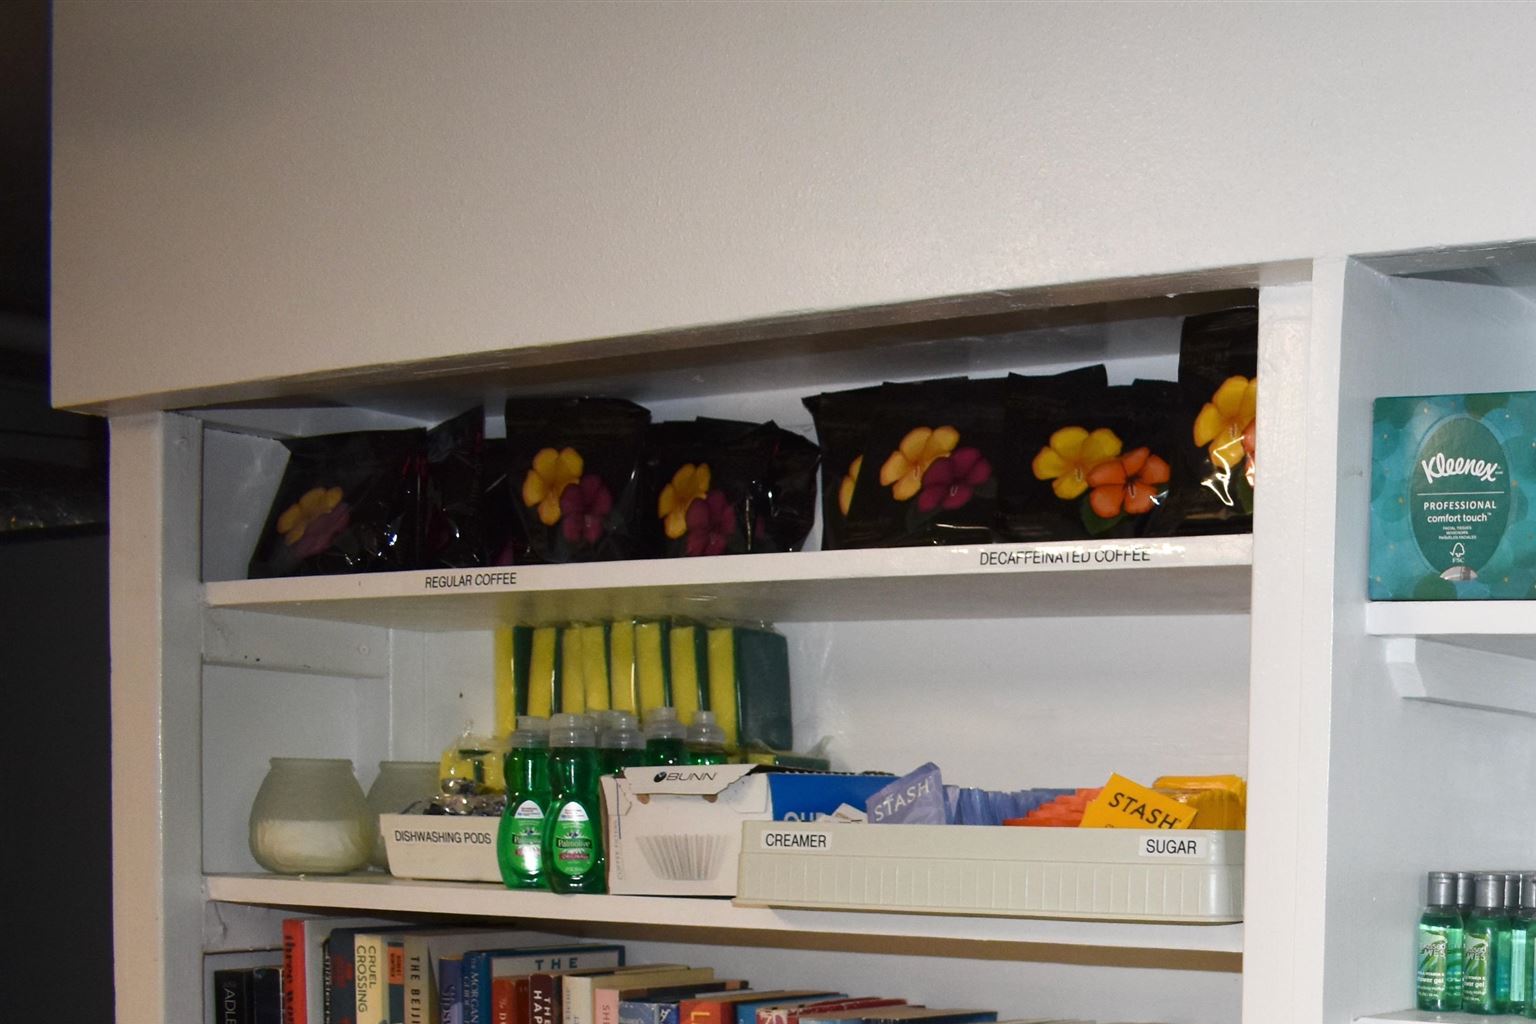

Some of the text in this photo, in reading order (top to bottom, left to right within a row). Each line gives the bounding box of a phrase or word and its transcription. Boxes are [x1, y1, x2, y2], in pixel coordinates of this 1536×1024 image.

[1421, 452, 1498, 484] Kleenex
[1423, 500, 1497, 511] PROFESSIONAL
[980, 549, 1151, 565] DECAFFEINATED COFFEE
[425, 572, 517, 588] REGULAR COFFEE
[666, 772, 717, 782] BUNN
[873, 777, 932, 823] STASH
[1108, 792, 1177, 829] STASH
[395, 831, 491, 844] DISHWASHING PODS
[558, 838, 591, 848] Palmolive
[765, 833, 827, 847] CREAMER
[1146, 839, 1197, 854] SUGAR
[368, 945, 378, 989] CRUEL
[410, 955, 421, 981] THE
[535, 957, 578, 971] THE
[356, 945, 368, 1013] CROSSING
